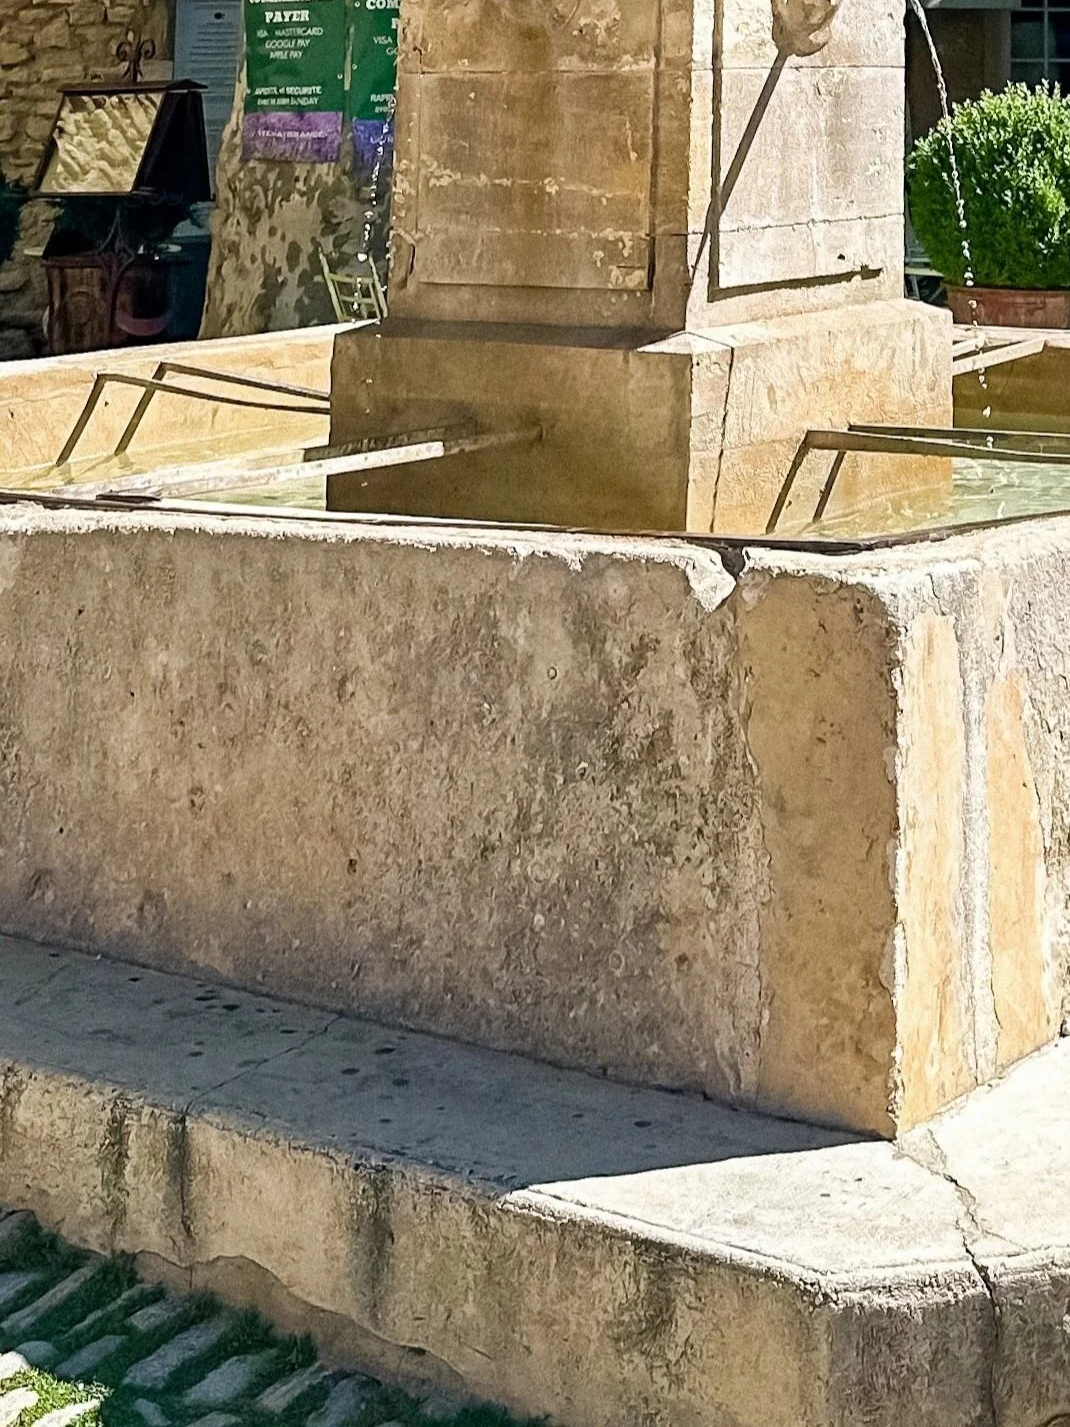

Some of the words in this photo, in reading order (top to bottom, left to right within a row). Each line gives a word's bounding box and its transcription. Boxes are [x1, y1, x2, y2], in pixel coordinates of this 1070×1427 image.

[264, 9, 310, 23] PAYER
[275, 27, 324, 37] MASTERCARD
[265, 39, 295, 49] GOOGLE
[297, 39, 311, 48] PAY
[373, 36, 393, 45] VISA
[289, 50, 303, 59] PAY
